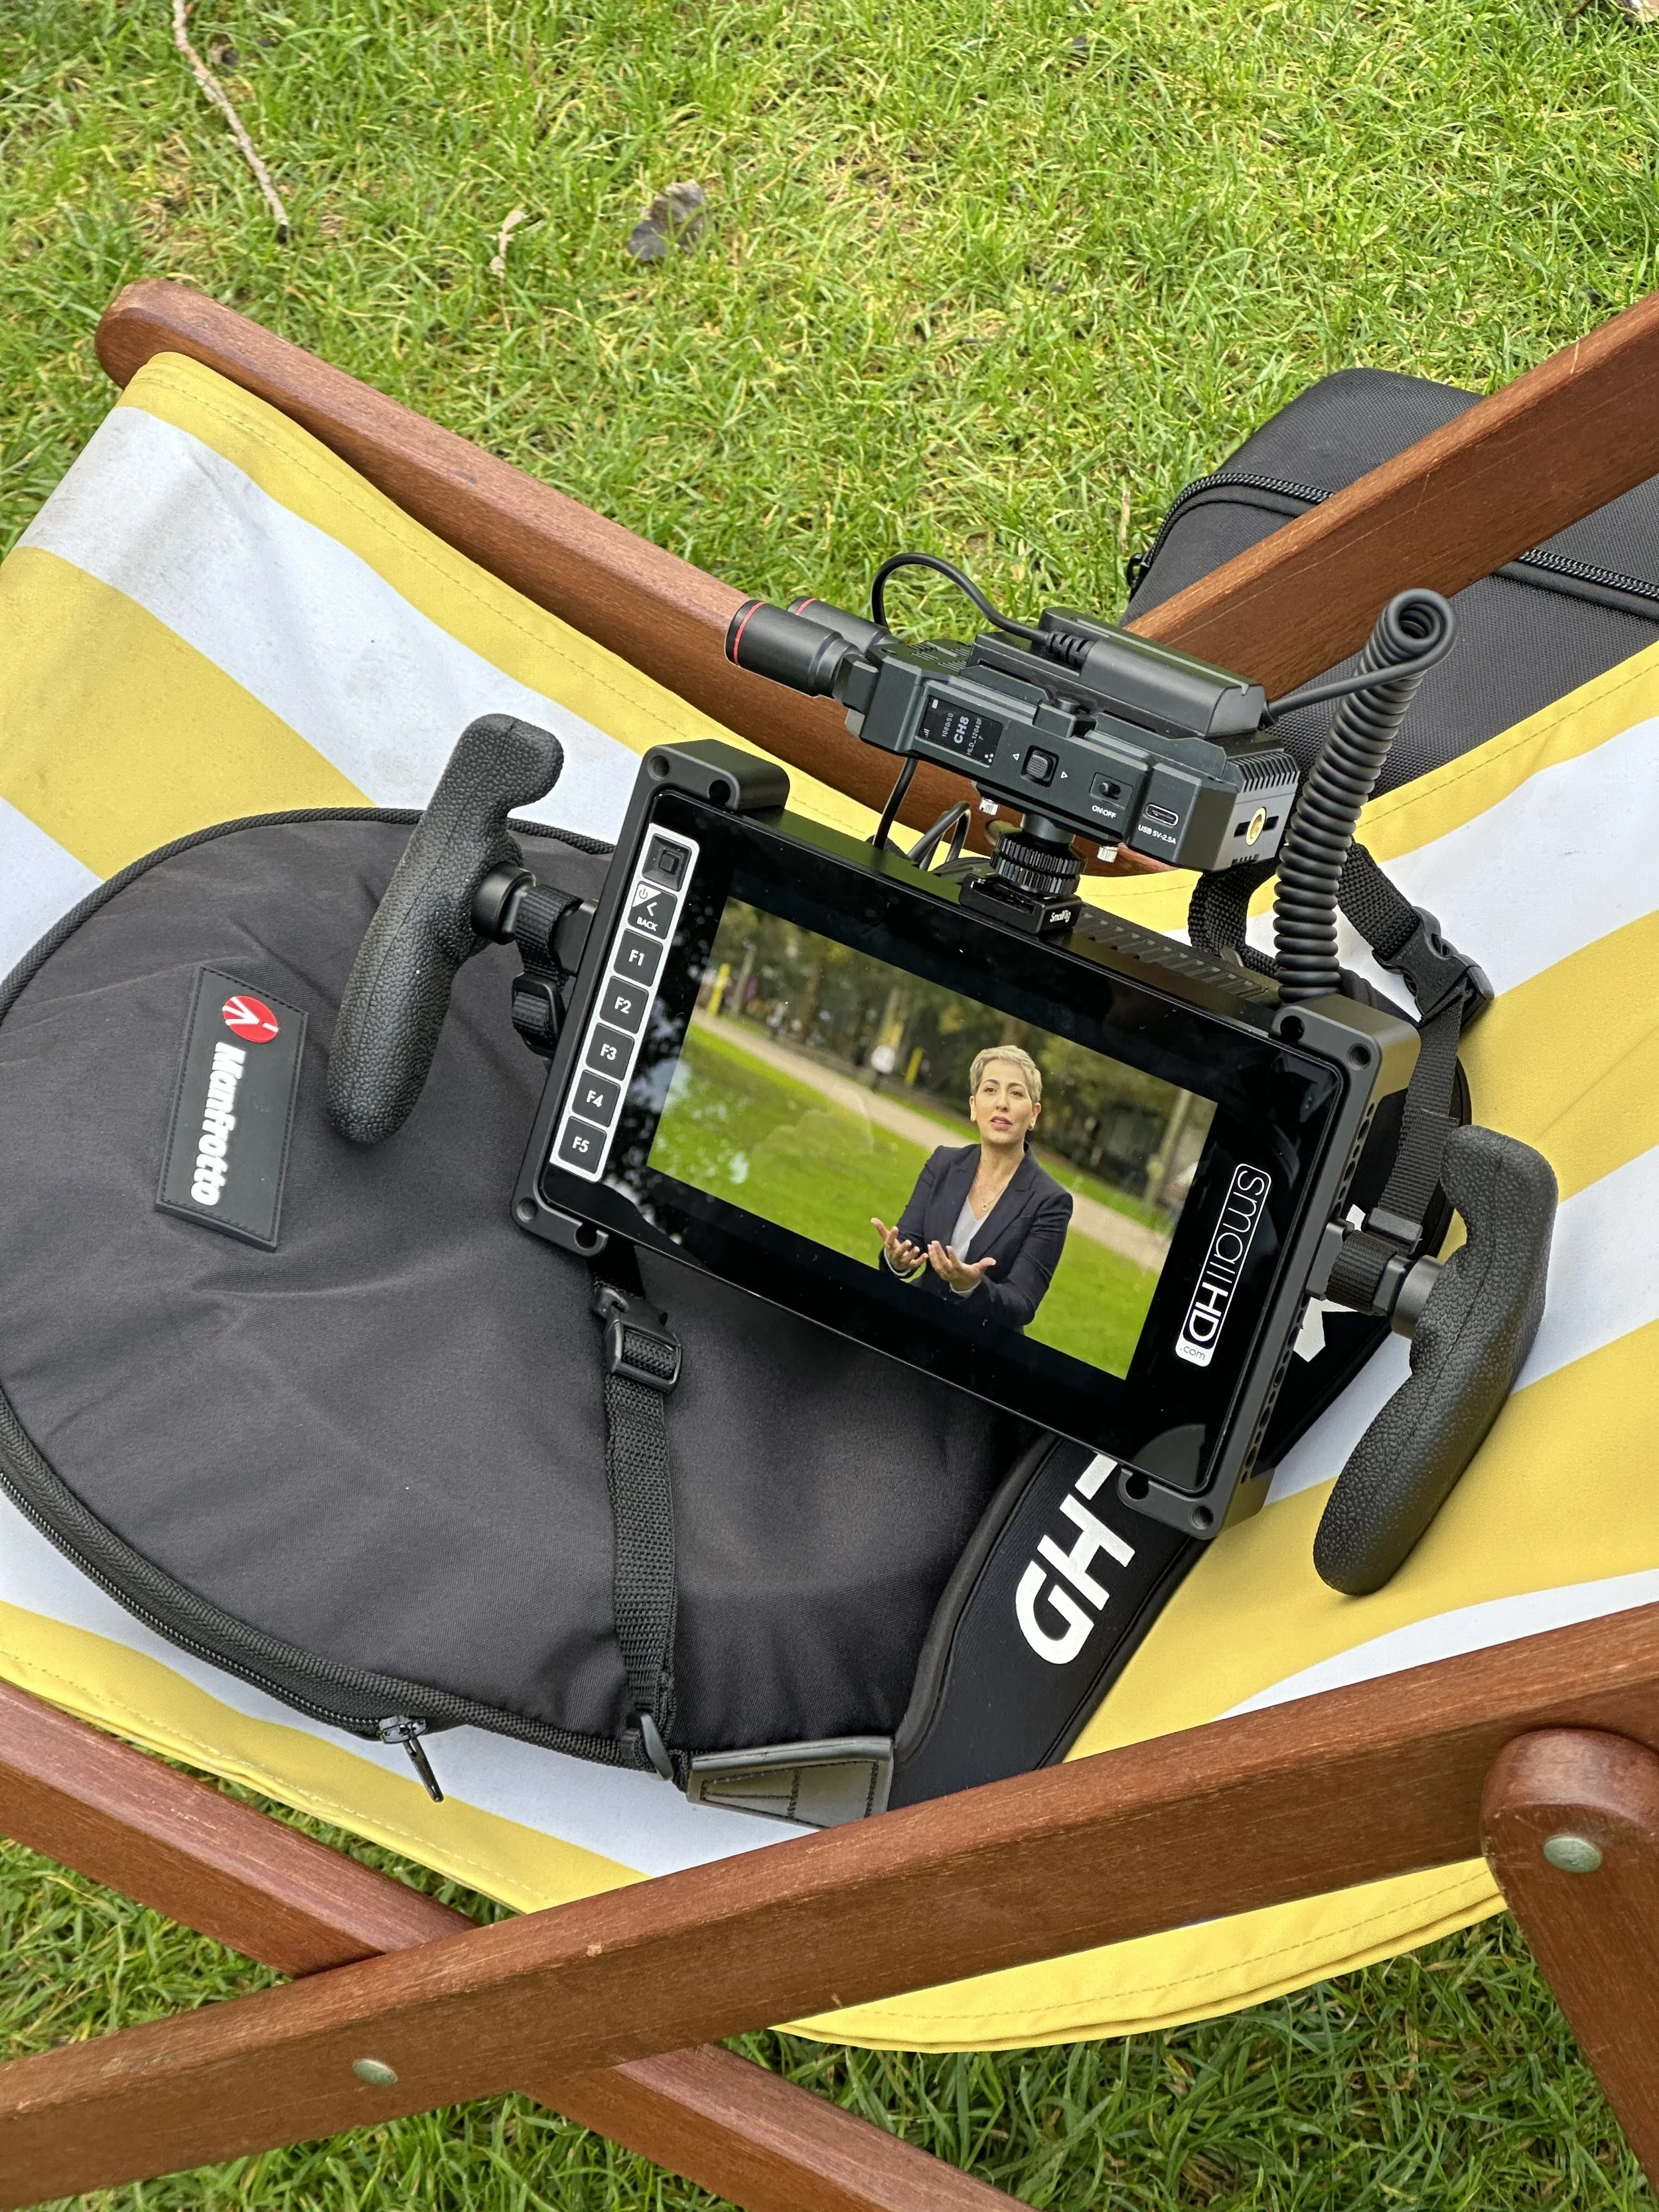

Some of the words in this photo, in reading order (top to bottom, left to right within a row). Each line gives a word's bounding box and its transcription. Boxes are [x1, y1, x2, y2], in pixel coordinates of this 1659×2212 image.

[954, 716, 969, 743] CH8
[1138, 824, 1152, 835] USB
[637, 916, 658, 932] BACK
[629, 949, 646, 966] F1
[614, 997, 632, 1014] F2
[600, 1044, 617, 1061] F3
[586, 1090, 603, 1108] F4
[191, 1041, 246, 1206] Manfrotto
[572, 1137, 590, 1153] F5
[1179, 1344, 1206, 1361] .com
